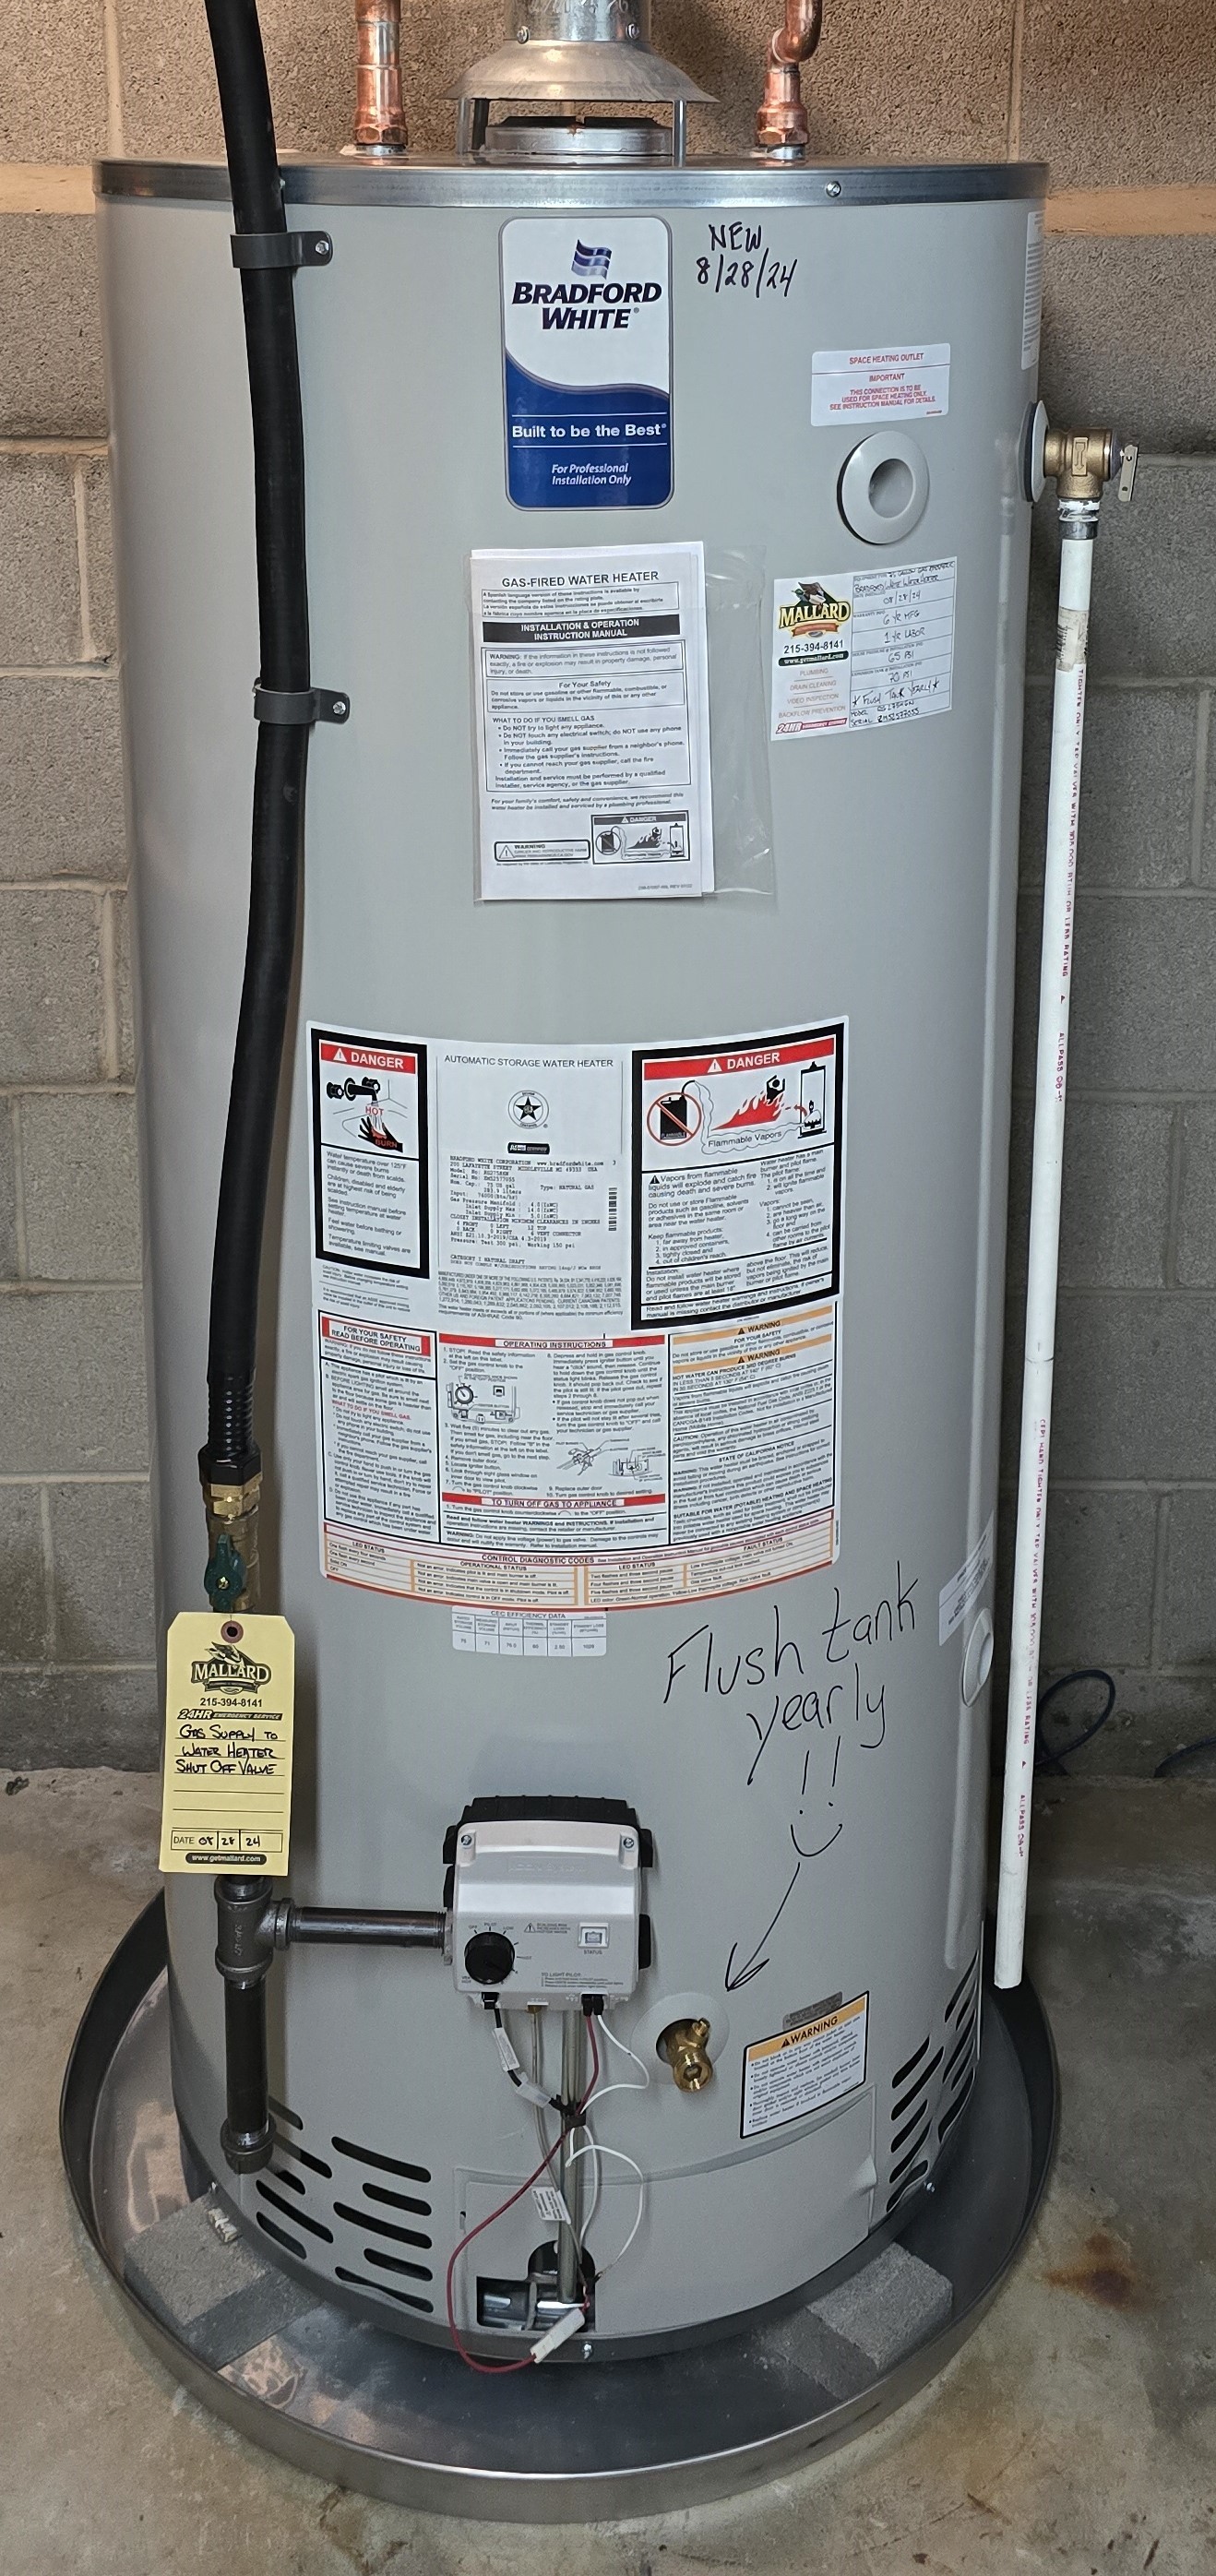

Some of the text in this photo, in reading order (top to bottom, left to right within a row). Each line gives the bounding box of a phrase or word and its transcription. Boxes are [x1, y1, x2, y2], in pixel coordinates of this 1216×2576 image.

[709, 221, 762, 254] NEW
[697, 247, 797, 298] 8/28/24
[512, 282, 662, 304] BRADFORD
[849, 352, 924, 364] SPACE HEATING OUTLET
[869, 373, 905, 382] IMPORTANT
[842, 401, 879, 411] INSTRUCTION
[512, 425, 547, 438] Built
[554, 426, 567, 438] to
[570, 425, 593, 437] be
[594, 425, 621, 437] the
[552, 463, 629, 475] For Professional
[553, 473, 633, 486] Installation Only
[502, 570, 659, 588] GAS-FIRED WATER HEATER
[883, 589, 921, 605] 08/28/24
[780, 602, 850, 628] MALLARD
[883, 614, 890, 626] 6
[520, 618, 639, 632] INSTALLATION & OPERATION
[534, 628, 627, 641] INSTRUCTION MANUAL
[884, 631, 891, 644] 1
[783, 639, 844, 654] 215-394-8141
[888, 650, 901, 663] 65
[799, 668, 829, 677] PLUMBING
[559, 681, 570, 689] For
[590, 680, 612, 689] Safety
[790, 681, 837, 691] DRAIN CLEANING
[787, 693, 839, 705] VIDEO INSPECTION
[778, 705, 846, 720] BACKFLOW PREVENTION
[545, 723, 559, 732] light
[574, 722, 604, 731] appliance.
[775, 722, 803, 735] 24HR
[351, 1051, 404, 1069] DANGER
[445, 1055, 614, 1068] AUTOMATIC STORAGE WATER HEATER
[727, 1052, 781, 1070] DANGER
[365, 1106, 384, 1116] HOT
[375, 1139, 398, 1149] BURN
[708, 1130, 782, 1148] Flammable Vapors
[661, 1167, 738, 1183] Vapors from flammable
[648, 1172, 757, 1192] liquids will explode and catch fire
[747, 1320, 781, 1332] WARNING
[343, 1325, 407, 1343] FOR YOUR SAFETY
[331, 1330, 421, 1352] READ BEFORE OPERATING
[503, 1340, 606, 1349] OPERATING INSTRUCTIONS
[747, 1349, 781, 1362] WARNING
[507, 1499, 525, 1508] TURN
[573, 1499, 617, 1508] APPLIANCE
[459, 1561, 502, 1570] OPERATIONAL
[482, 1554, 595, 1565] CONTROL DIAGNOSTIC CODES
[507, 1611, 547, 1619] EFFICIENCY
[663, 1604, 805, 1704] Flush
[821, 1558, 919, 1663] tank
[194, 1663, 270, 1684] MALLARD
[200, 1698, 263, 1708] 215-394-8141
[177, 1709, 214, 1721] 24HR
[182, 1741, 279, 1759] WATER HEATER
[175, 1759, 278, 1775] SHUT OFF VALVE
[173, 1836, 196, 1845] DATE
[245, 1835, 261, 1848] 24
[191, 1854, 261, 1864] www.getmallard.com
[790, 2015, 839, 2045] WARNING
